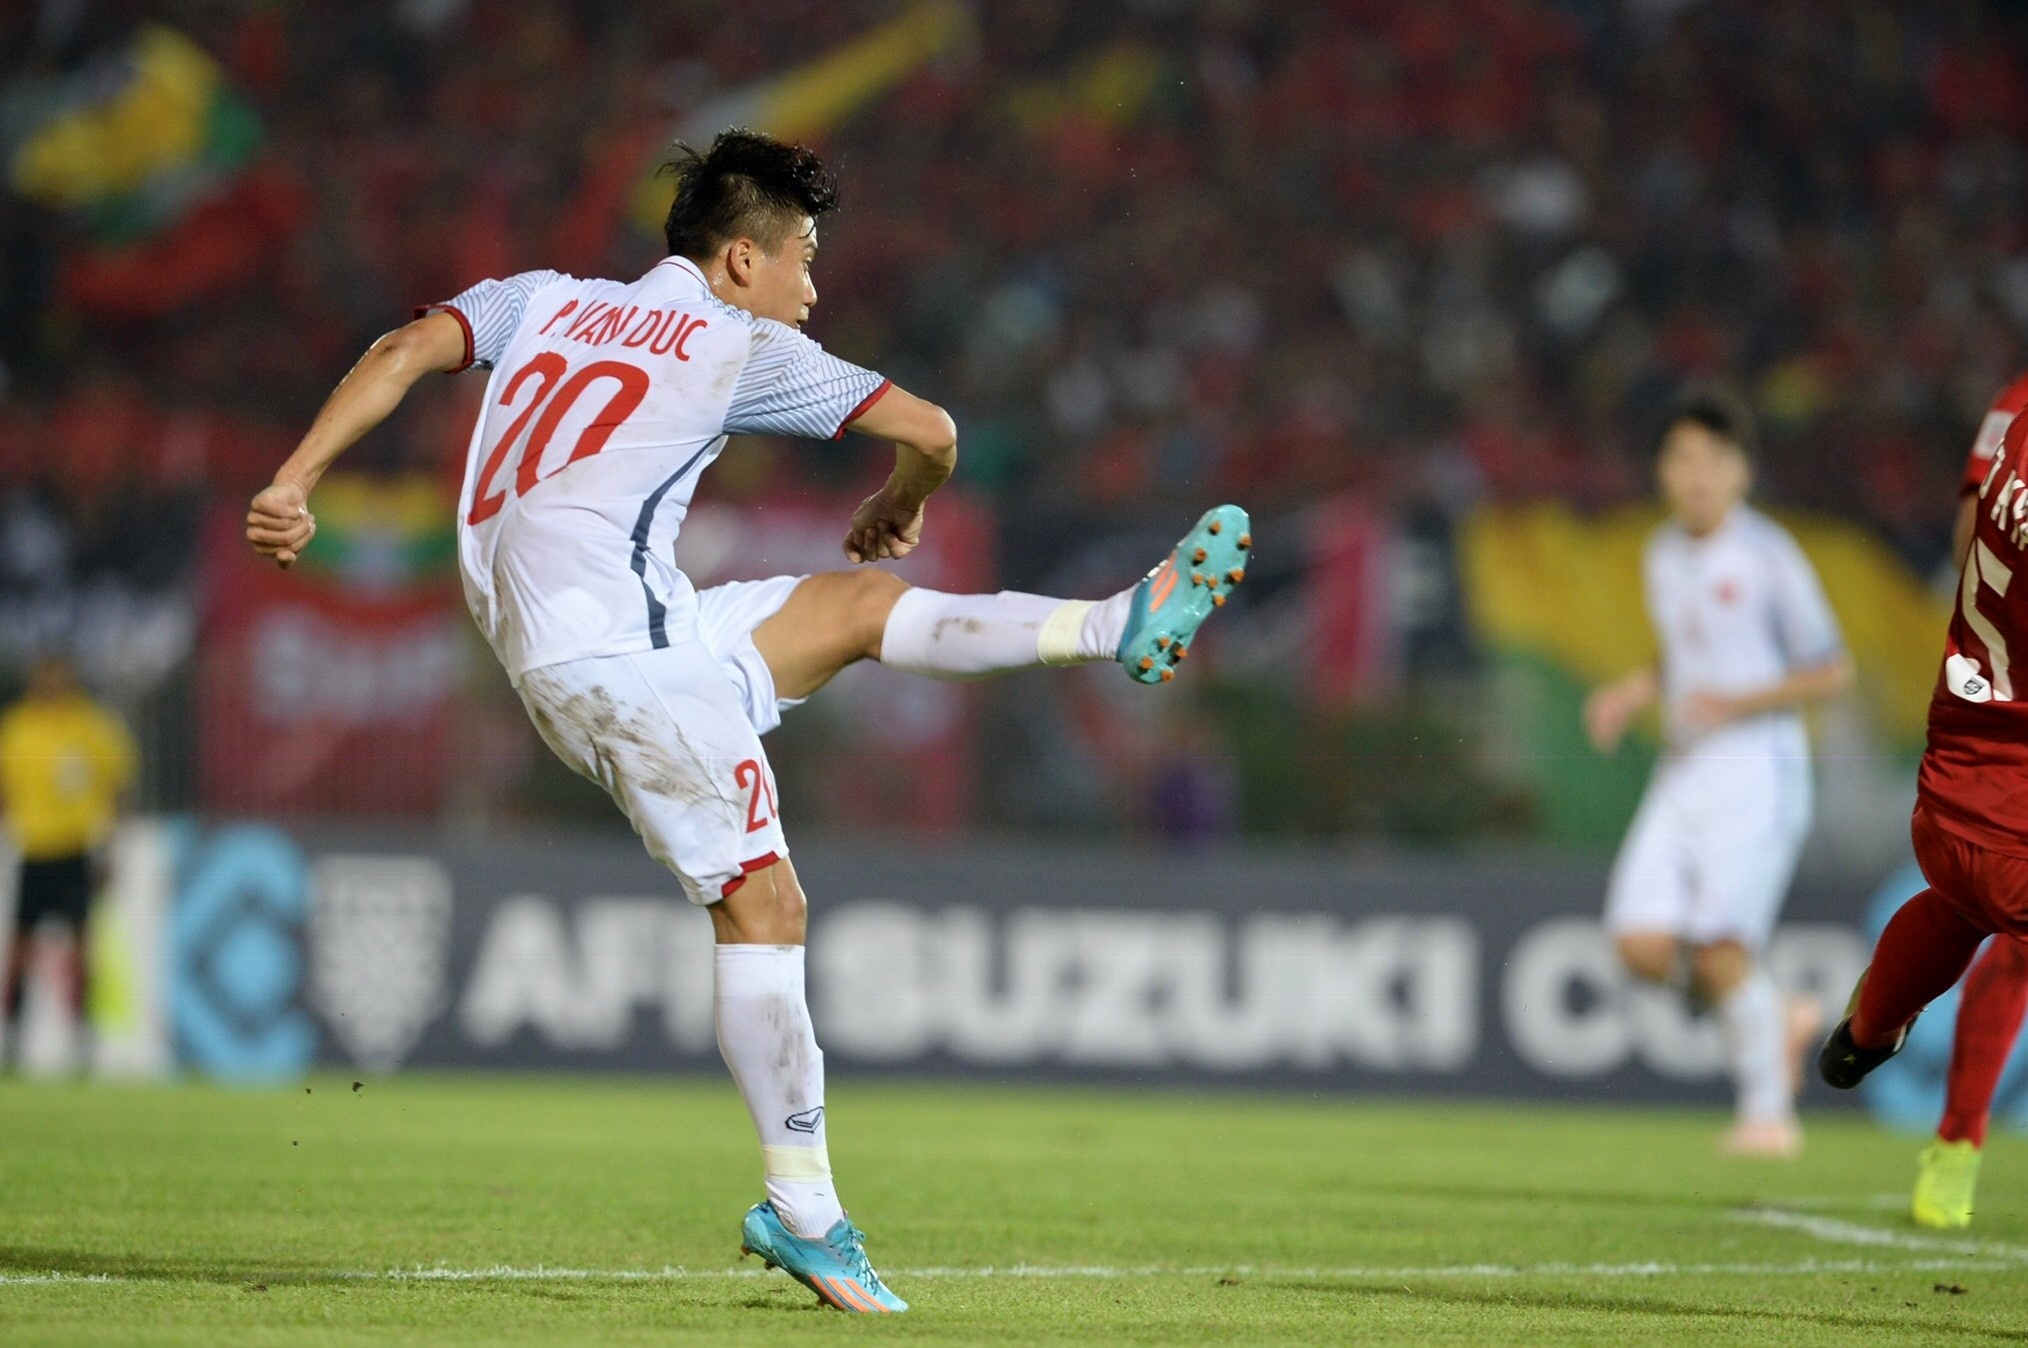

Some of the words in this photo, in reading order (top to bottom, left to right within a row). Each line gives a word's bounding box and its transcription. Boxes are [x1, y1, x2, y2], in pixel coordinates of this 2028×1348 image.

[621, 309, 708, 362] DUC
[467, 350, 650, 526] 20
[804, 902, 1477, 1070] SUZUKI
